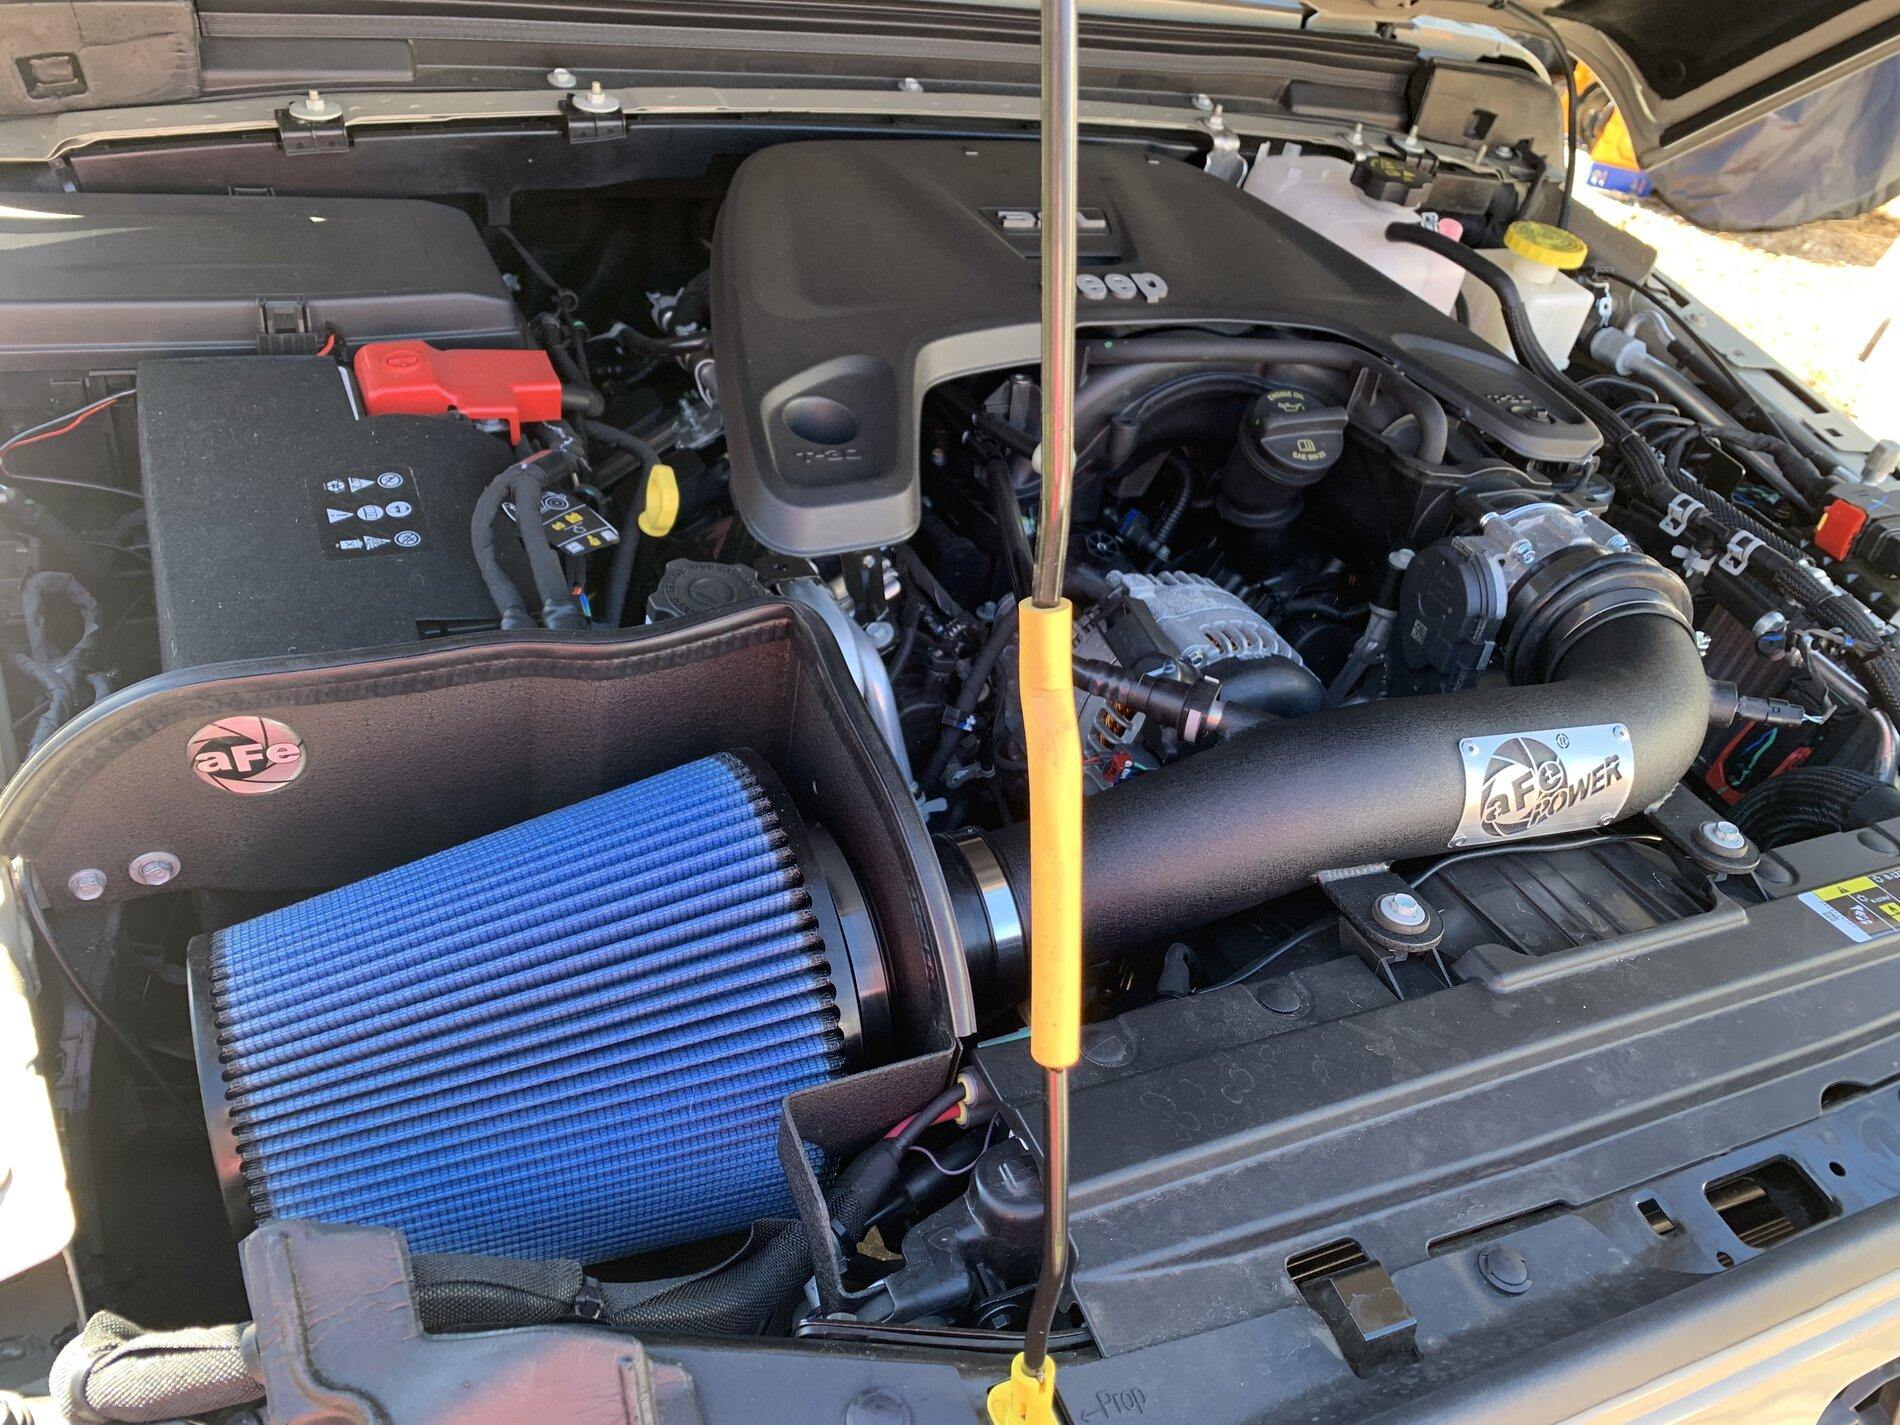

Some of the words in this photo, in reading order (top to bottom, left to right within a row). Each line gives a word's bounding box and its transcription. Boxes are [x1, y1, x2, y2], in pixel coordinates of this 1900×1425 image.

[1075, 272, 1169, 303] eep
[1267, 389, 1293, 401] ENGINE
[195, 742, 302, 773] aFe
[1527, 754, 1624, 830] POWER
